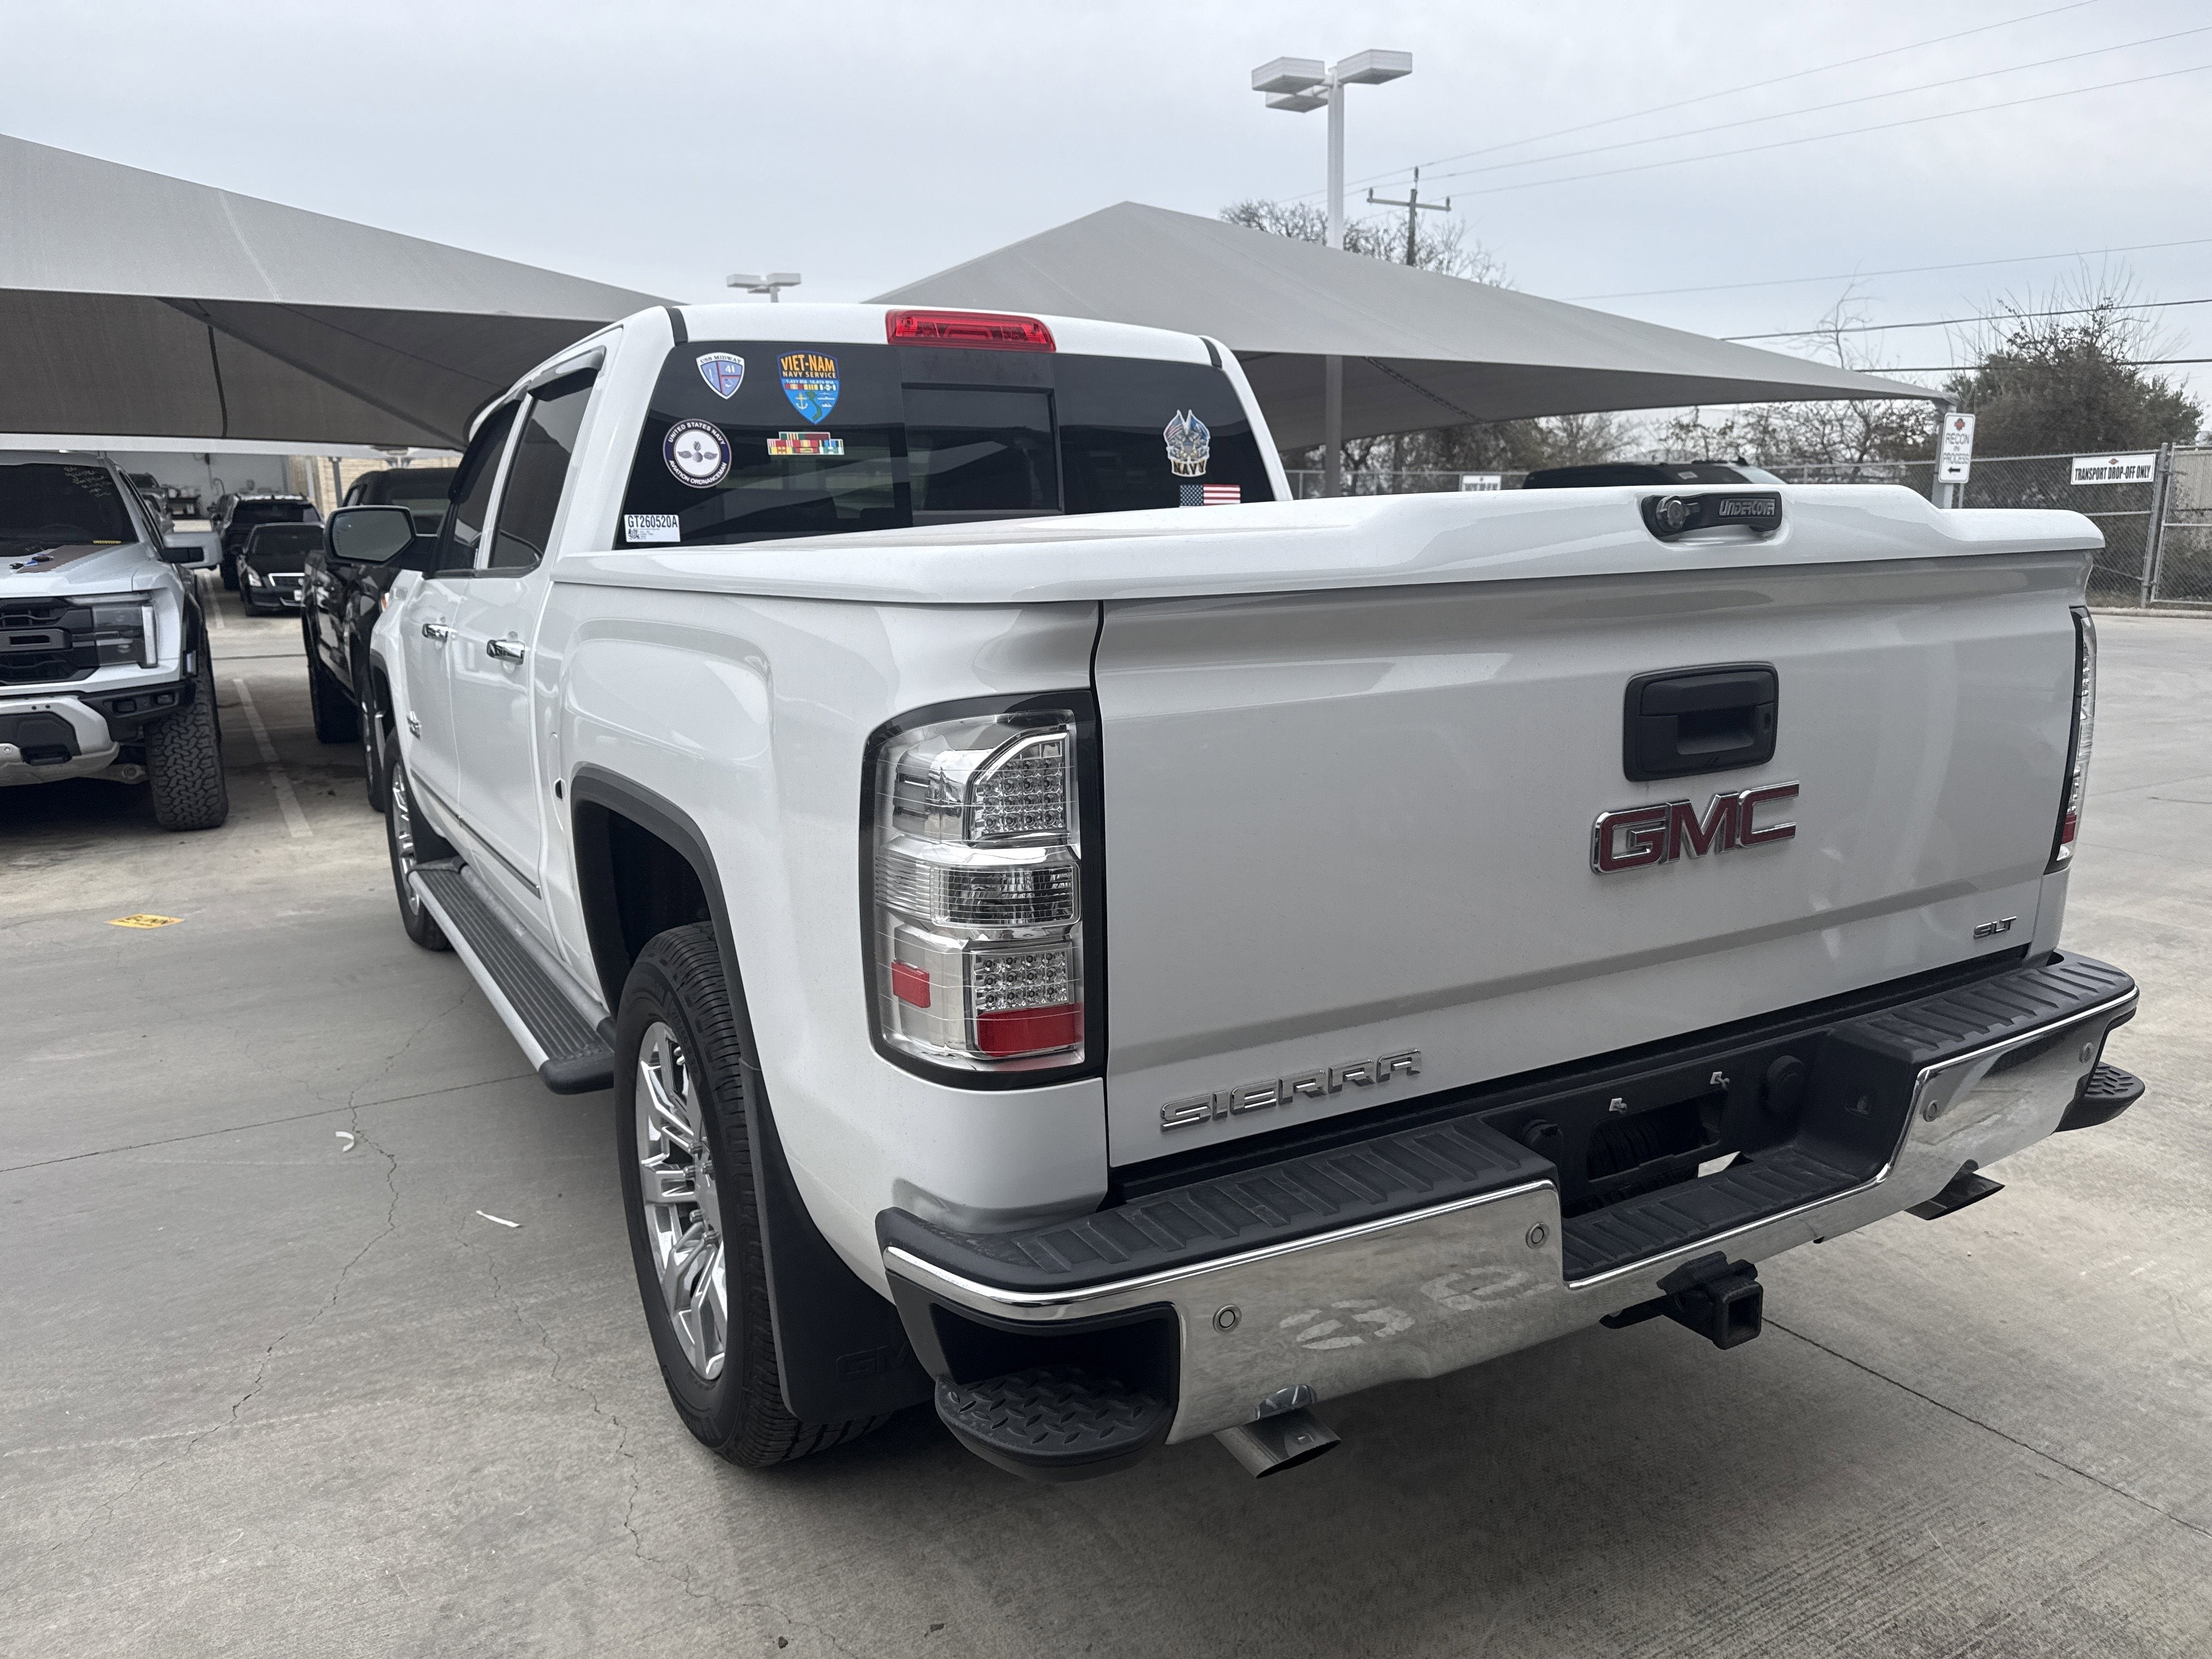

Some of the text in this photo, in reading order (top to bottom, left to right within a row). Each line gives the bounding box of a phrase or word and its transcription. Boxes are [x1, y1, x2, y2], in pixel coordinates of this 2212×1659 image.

[714, 355, 741, 364] MIDWAY
[781, 354, 835, 371] VIET-NAM
[725, 364, 735, 373] 41
[668, 422, 726, 444] UNITED STATES NAVY
[1945, 432, 1970, 445] RECON
[1943, 453, 1969, 465] PROCESS
[669, 460, 727, 485] AVIATION ORDNANCEMAN
[1173, 460, 1206, 475] NAVY
[2075, 465, 2151, 481] TRANSPORT DROP-OFF ONLY
[628, 516, 678, 528] GT260520A
[1590, 780, 1799, 874] GMC
[1973, 916, 2017, 939] SLT
[1160, 1048, 1421, 1133] SIERRA
